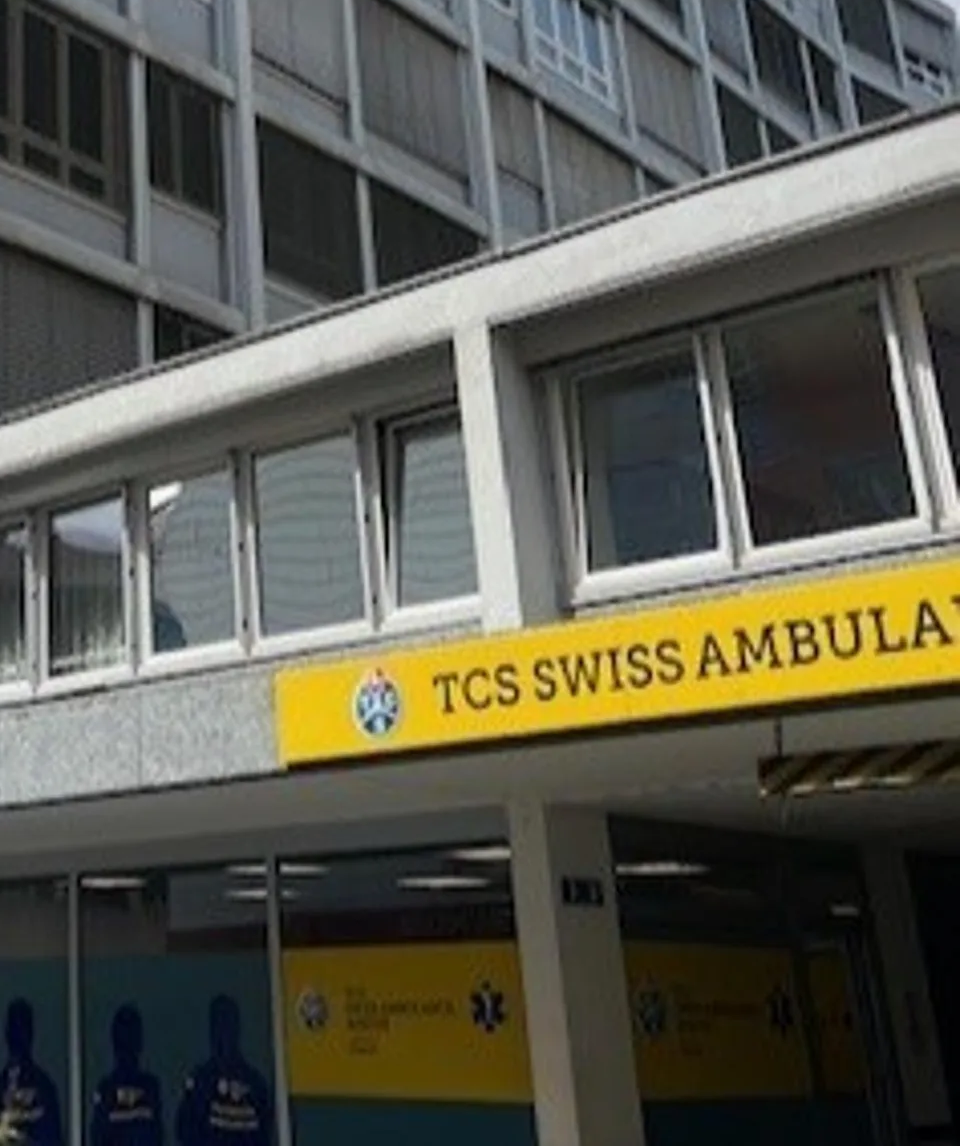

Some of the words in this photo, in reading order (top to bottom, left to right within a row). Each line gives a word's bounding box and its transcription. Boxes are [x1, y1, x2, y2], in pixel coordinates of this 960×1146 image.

[433, 662, 520, 714] TCS
[532, 639, 685, 702] SWISS
[695, 596, 960, 681] AMBULA
